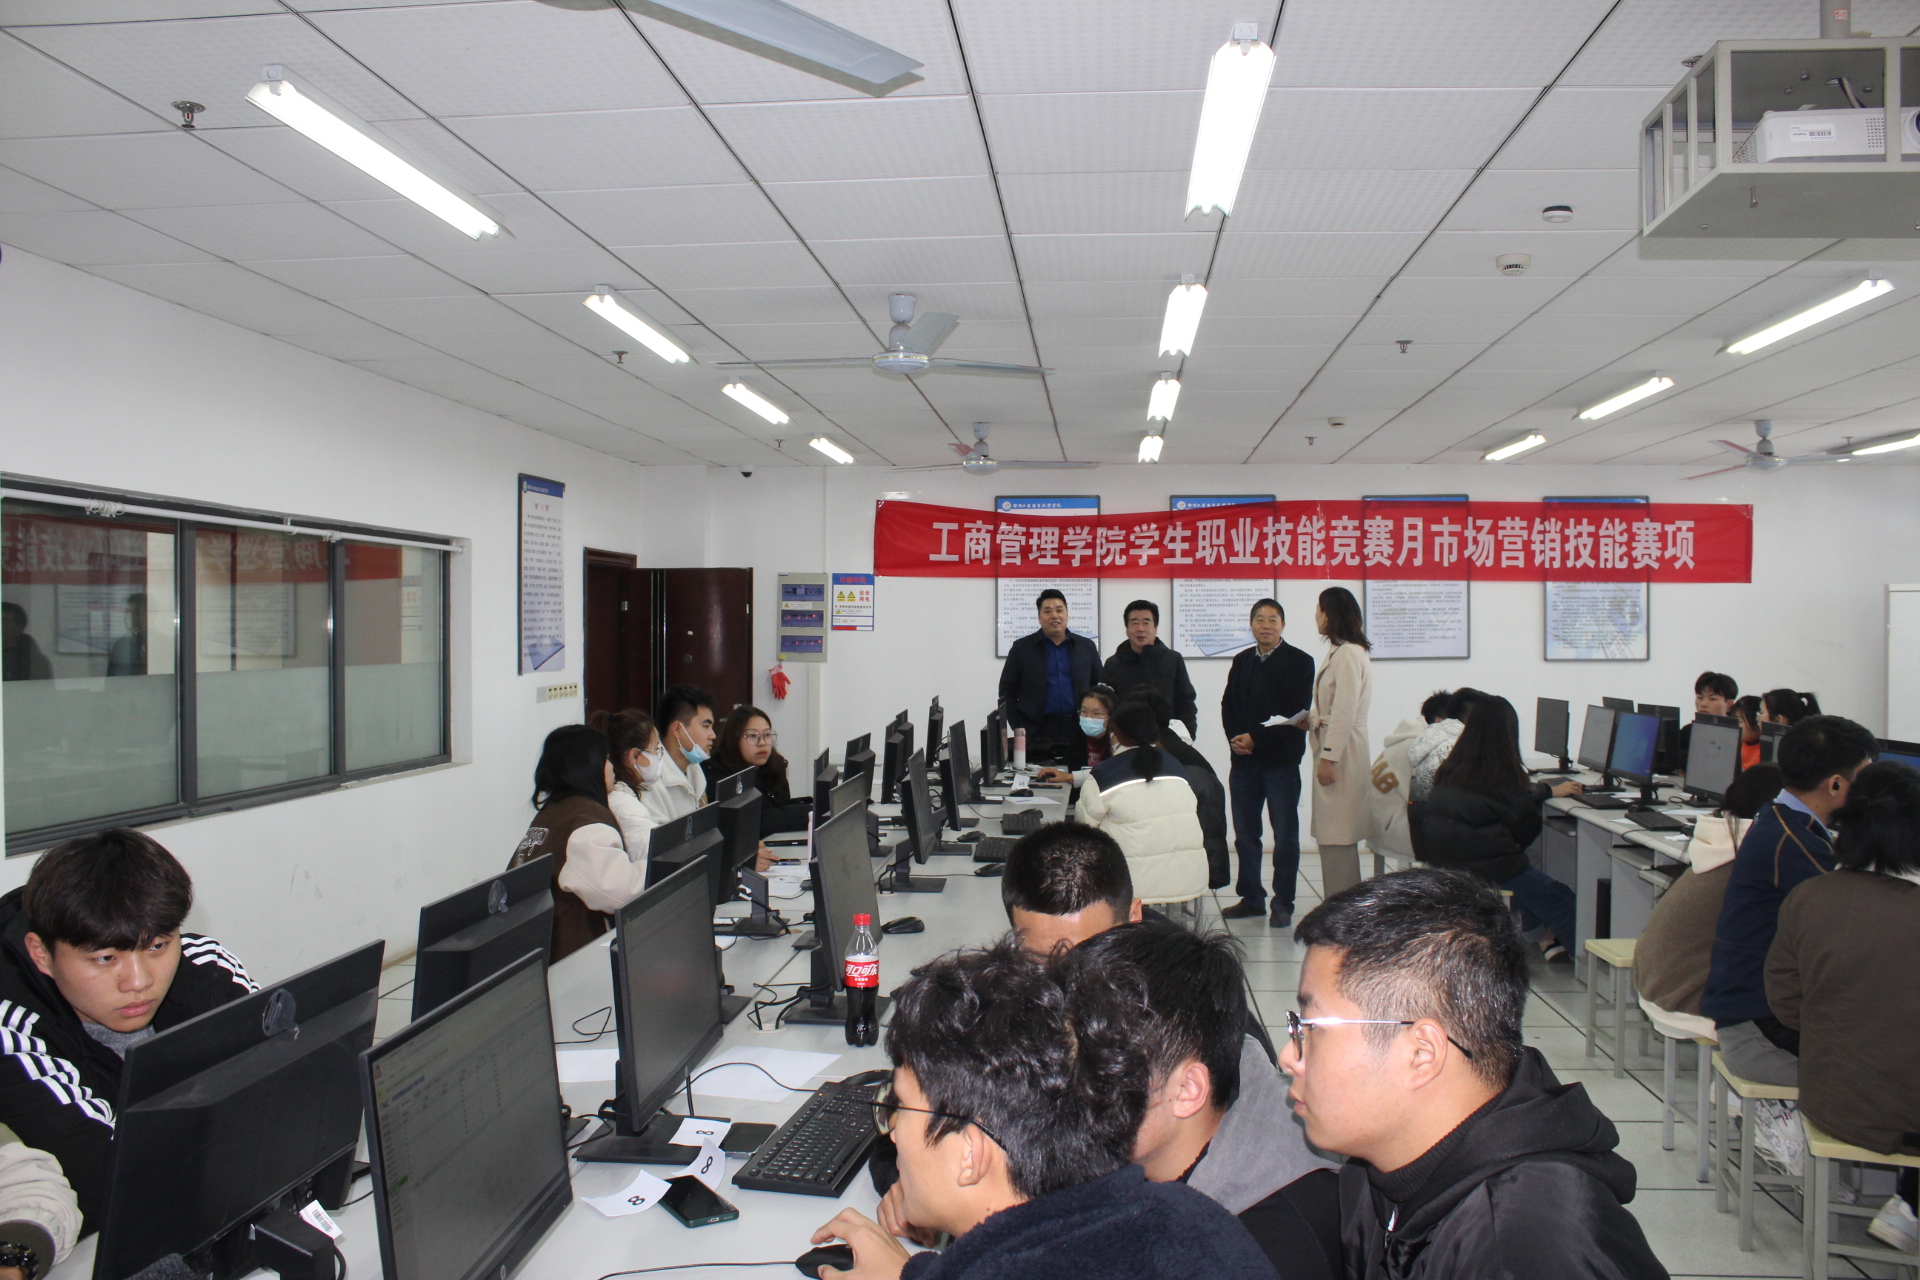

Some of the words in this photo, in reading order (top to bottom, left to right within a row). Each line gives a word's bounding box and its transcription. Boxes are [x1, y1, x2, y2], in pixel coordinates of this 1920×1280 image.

[929, 515, 1695, 569] 工商管理学院学生职业技能竞赛月市场营销技能赛项
[846, 963, 878, 977] 可口可乐
[701, 1156, 713, 1174] 8
[628, 1195, 646, 1206] 8
